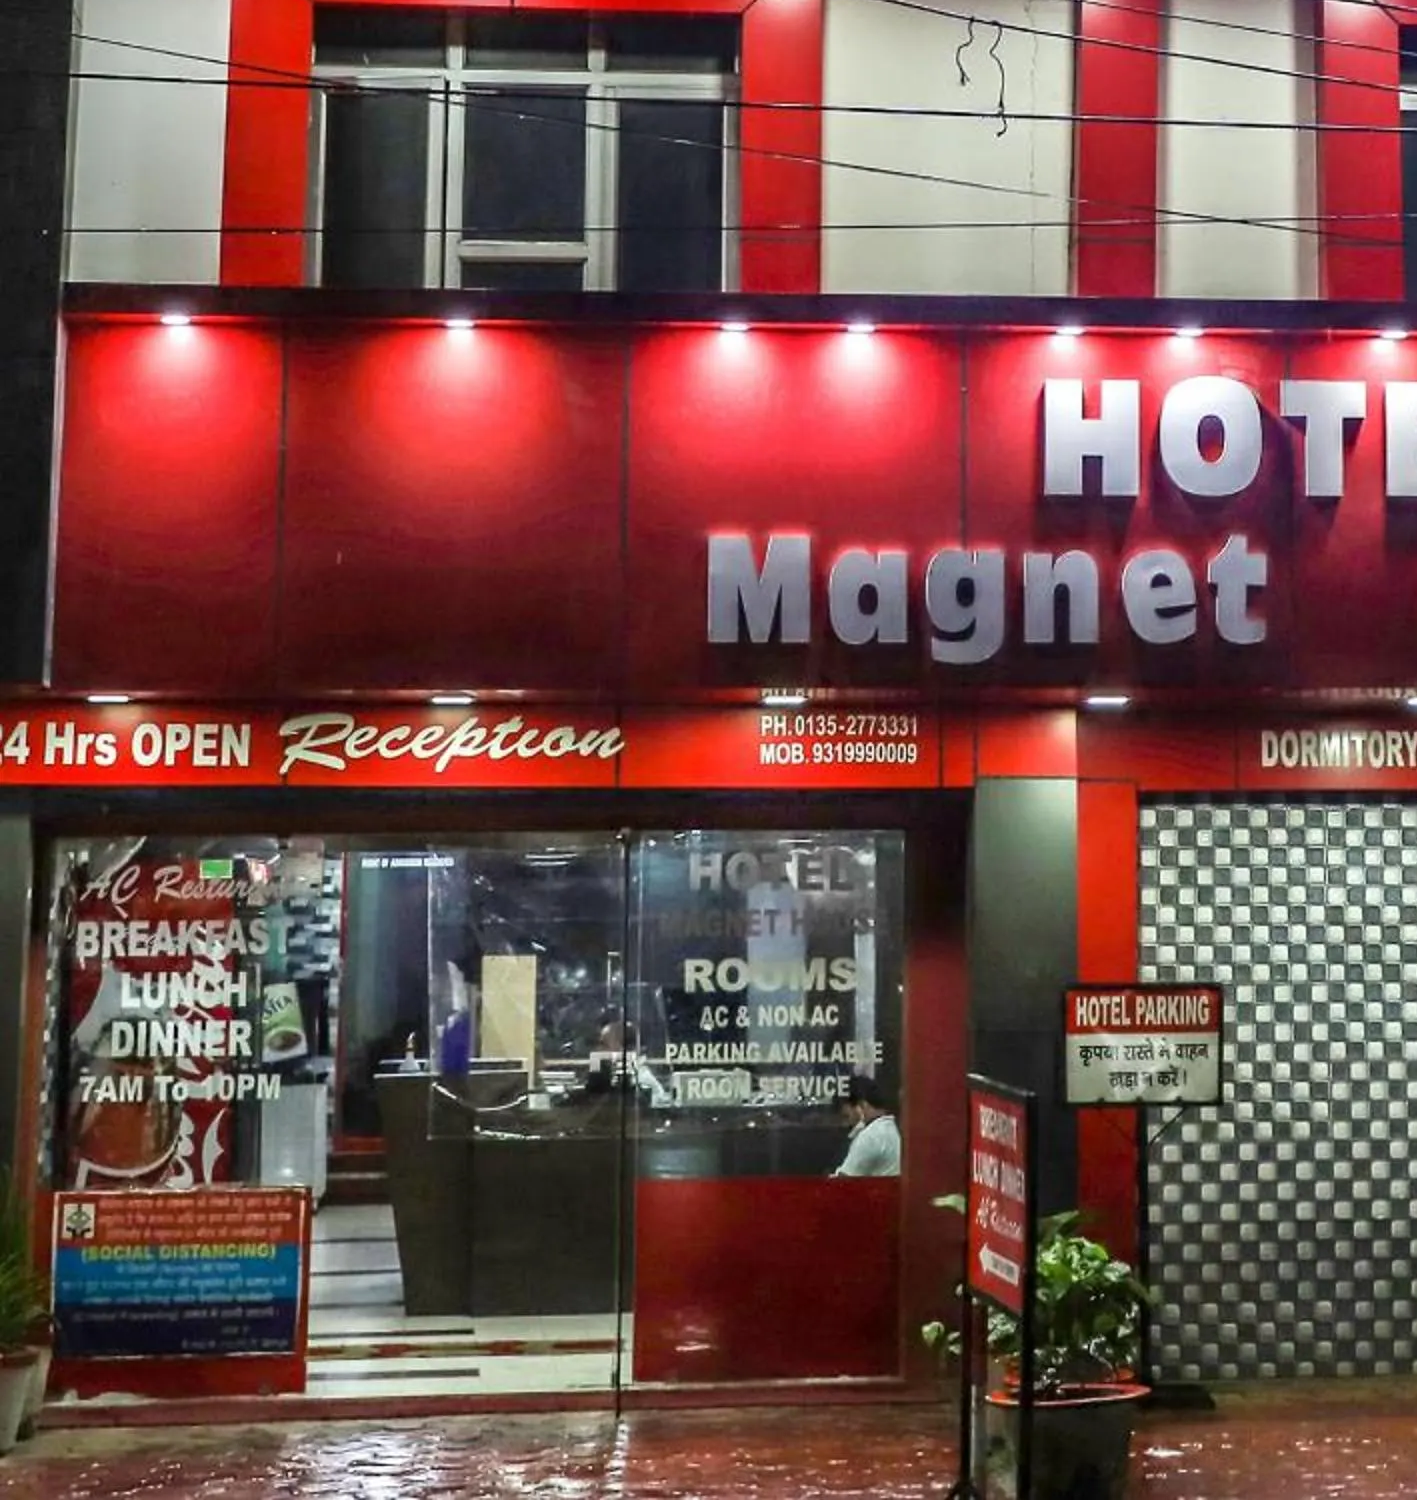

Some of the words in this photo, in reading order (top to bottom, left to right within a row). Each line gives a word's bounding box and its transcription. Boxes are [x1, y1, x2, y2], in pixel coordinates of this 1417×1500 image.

[706, 532, 1268, 665] Magnet
[0, 721, 30, 766] 4
[44, 722, 118, 766] Hrs
[131, 722, 250, 768] OPEN
[279, 713, 625, 775] Reception
[75, 918, 296, 959] BREAKFAST
[121, 970, 248, 1008] LUNCH
[684, 956, 857, 994] ROOMS
[700, 1005, 729, 1030] AC
[735, 1006, 751, 1027] &
[757, 1005, 804, 1027] NON
[810, 1005, 840, 1027] AC
[1076, 996, 1131, 1027] HOTEL
[1136, 995, 1210, 1025] PARKING
[111, 1020, 252, 1057] DINNER
[665, 1042, 761, 1065] PARKING
[767, 1041, 884, 1064] AVAILABLE
[758, 1074, 850, 1098] SERVICE
